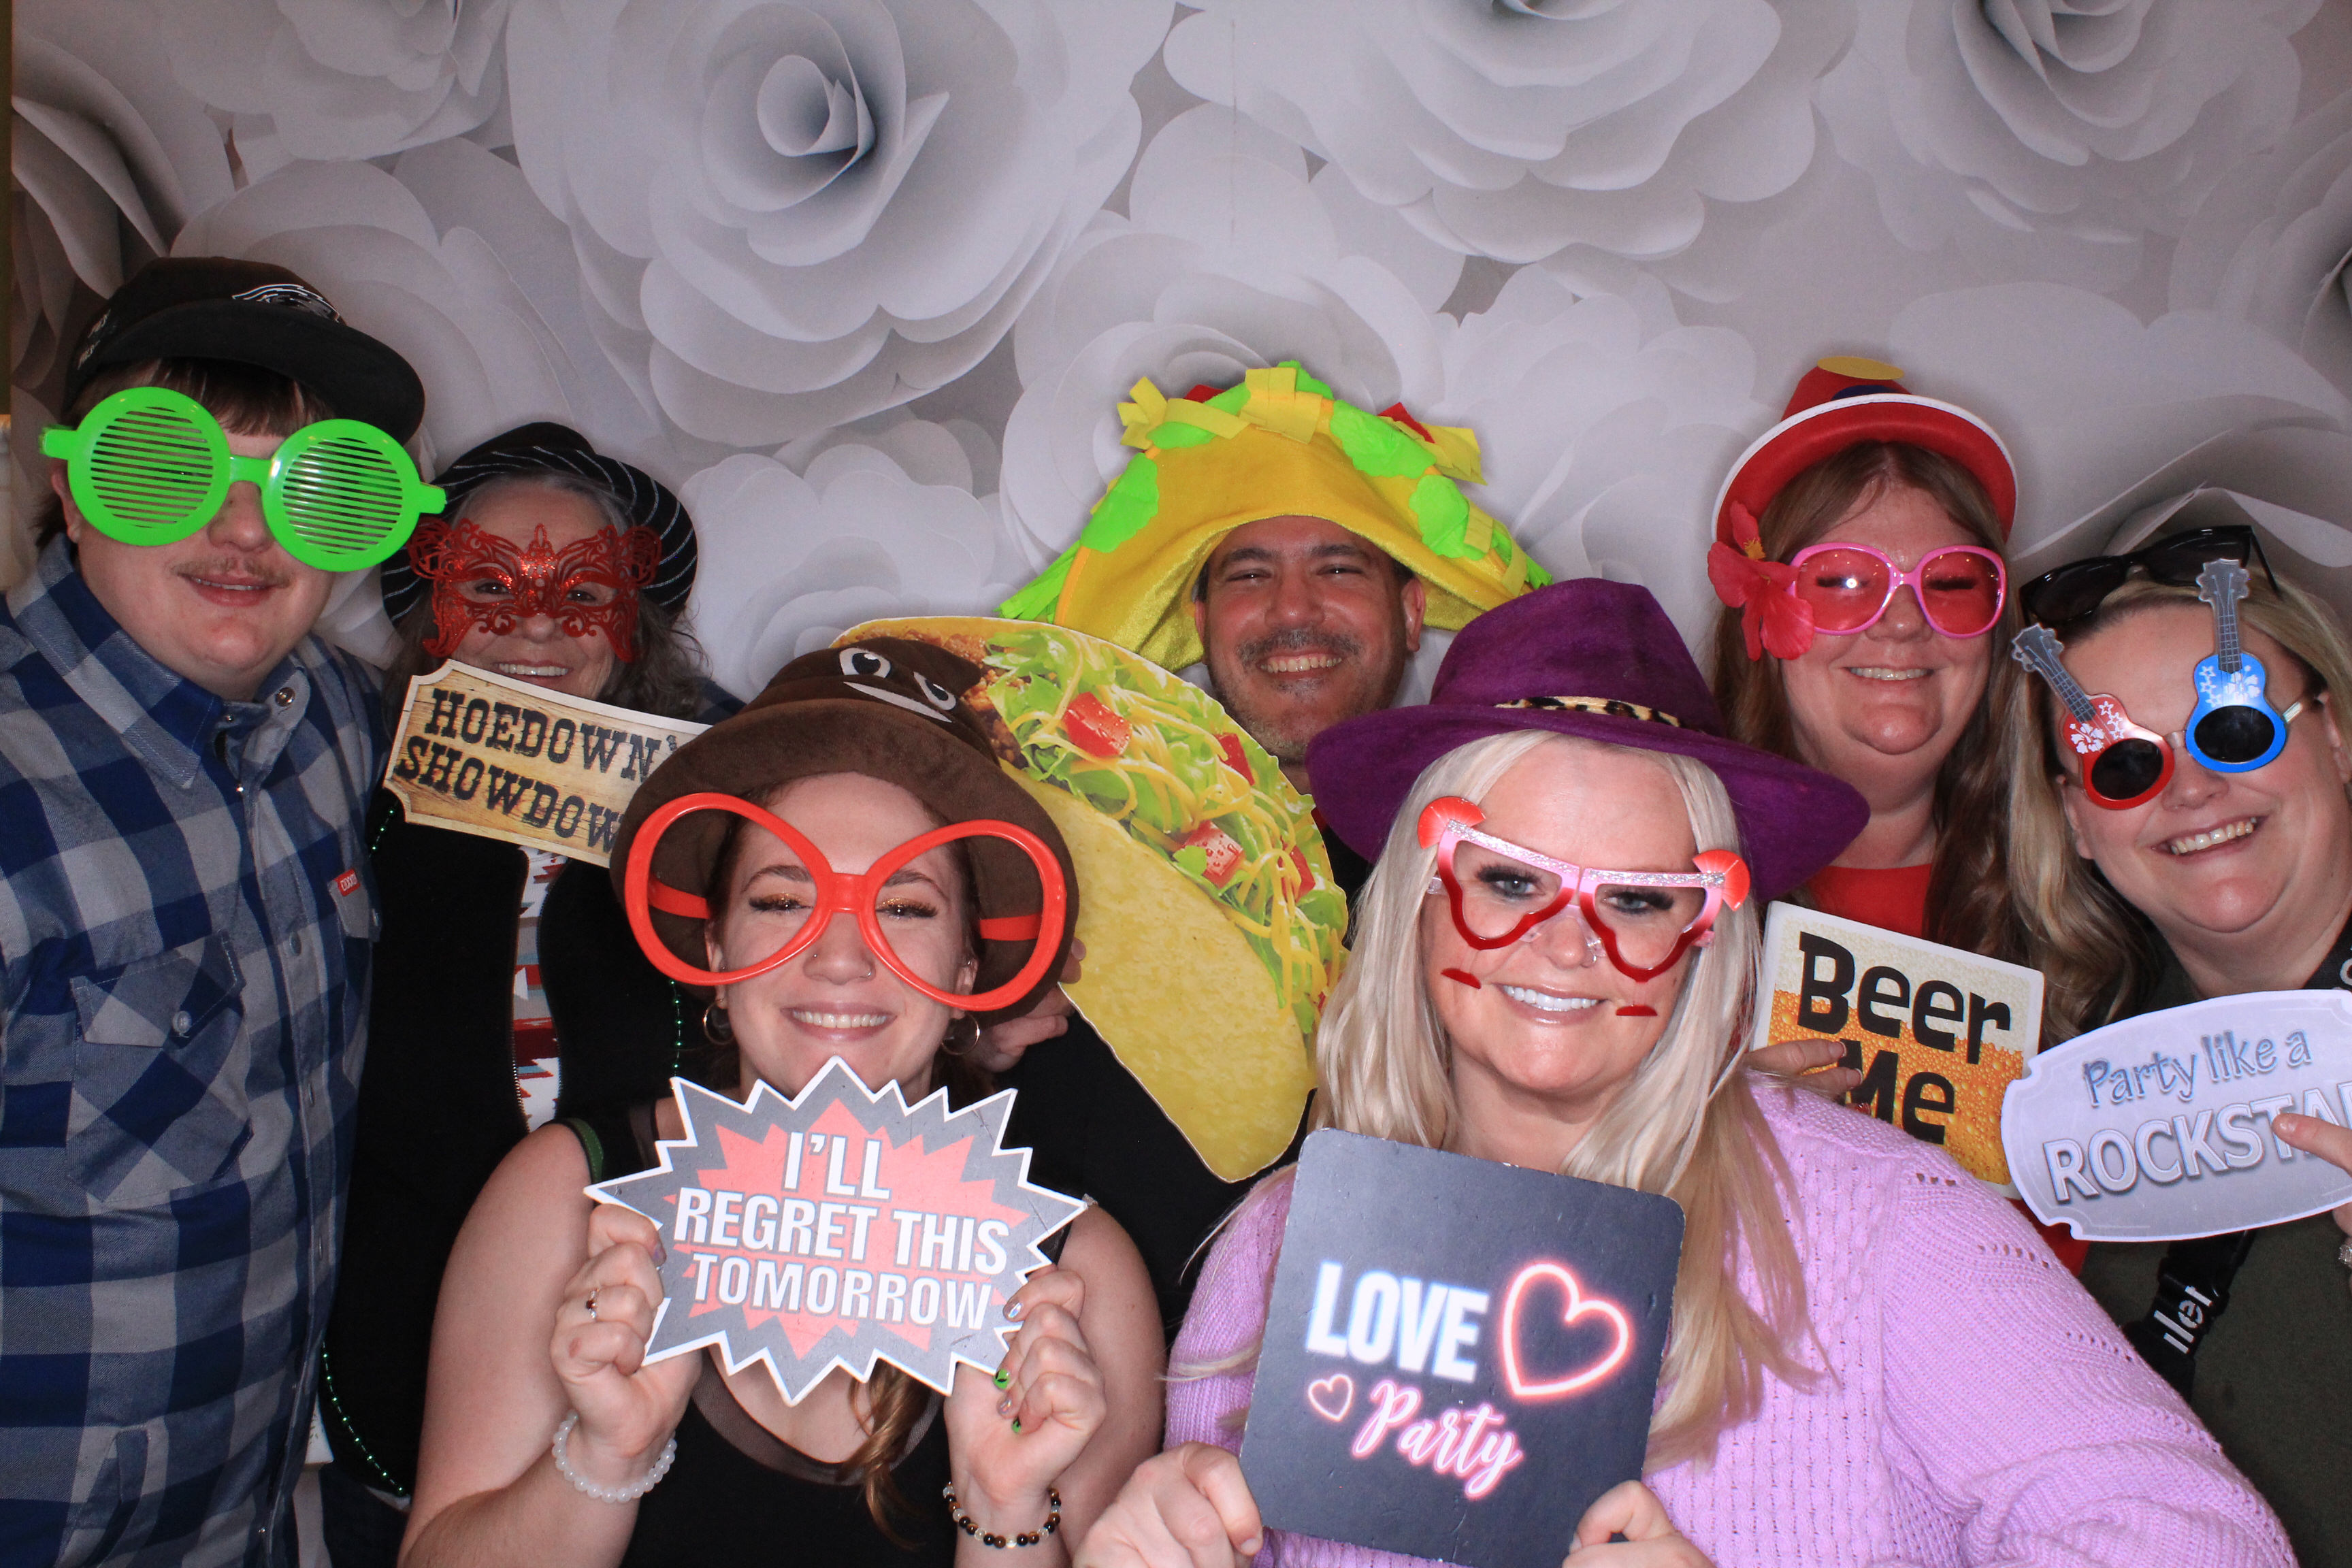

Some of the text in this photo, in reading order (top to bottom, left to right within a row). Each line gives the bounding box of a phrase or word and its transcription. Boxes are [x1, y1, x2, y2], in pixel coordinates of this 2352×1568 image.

[395, 735, 625, 853] SHOWDOW
[1797, 931, 2011, 1065] Beer
[2084, 1028, 2313, 1107] Party like a
[783, 1132, 891, 1200] I'LL
[2042, 1081, 2352, 1203] ROCKSTA
[673, 1186, 1010, 1275] REGRET THIS
[692, 1253, 992, 1330] TOMORROW
[1305, 1261, 1490, 1384] LOVE
[1352, 1379, 1525, 1499] Party
